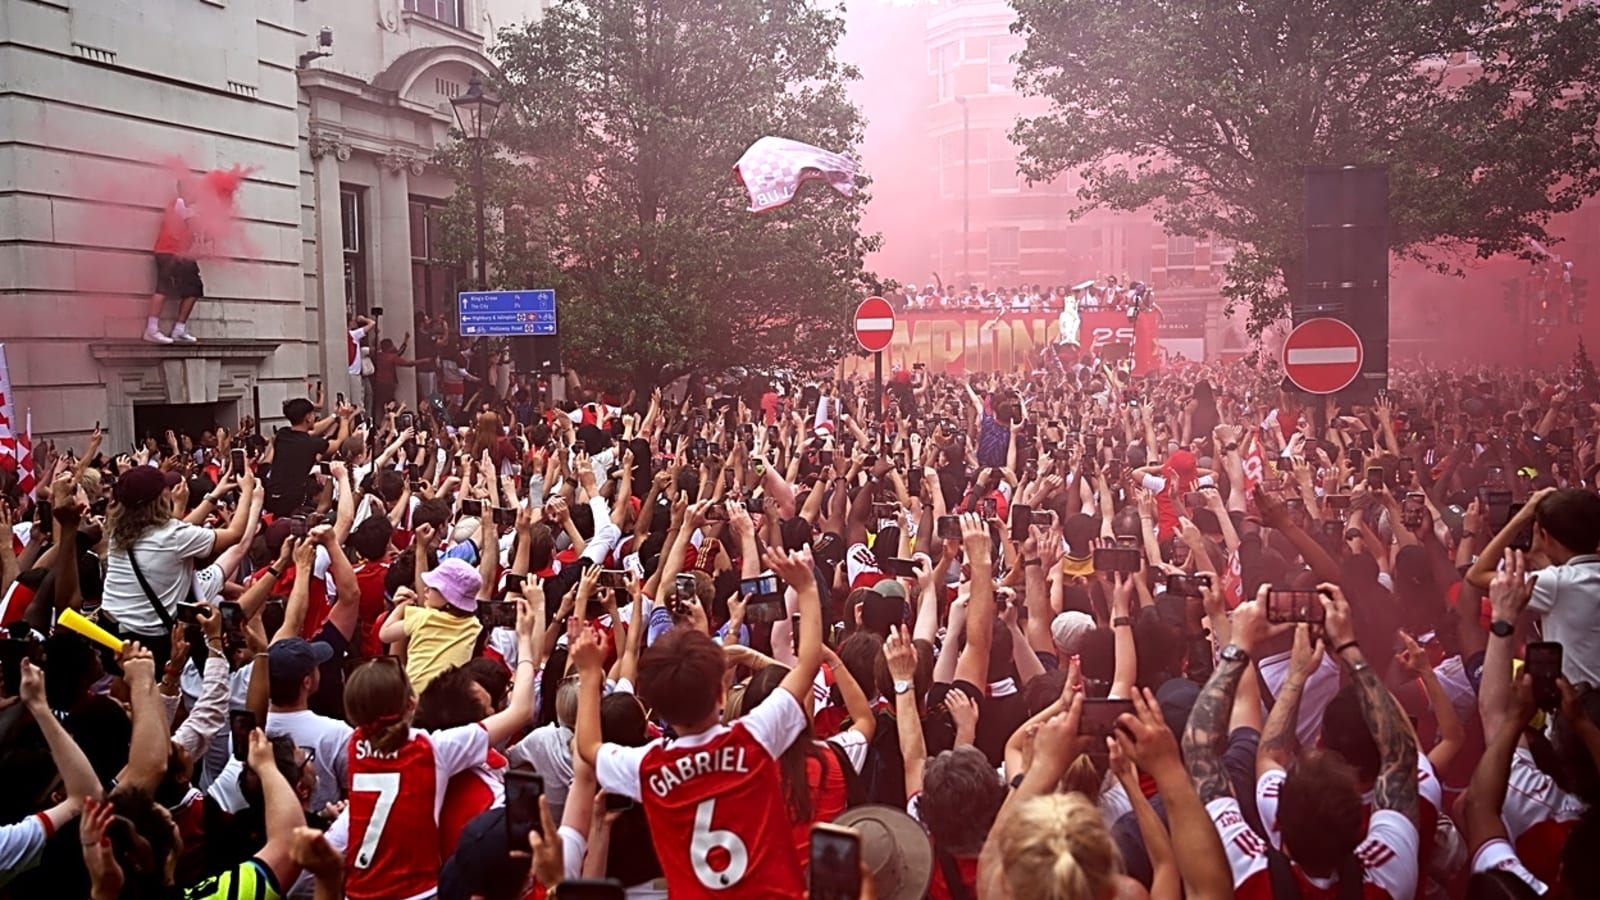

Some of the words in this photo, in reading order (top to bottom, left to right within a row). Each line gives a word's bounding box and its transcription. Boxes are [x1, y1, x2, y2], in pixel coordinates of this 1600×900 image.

[649, 746, 749, 798] GABRIEL
[352, 772, 401, 870] 7
[690, 797, 748, 890] 6
